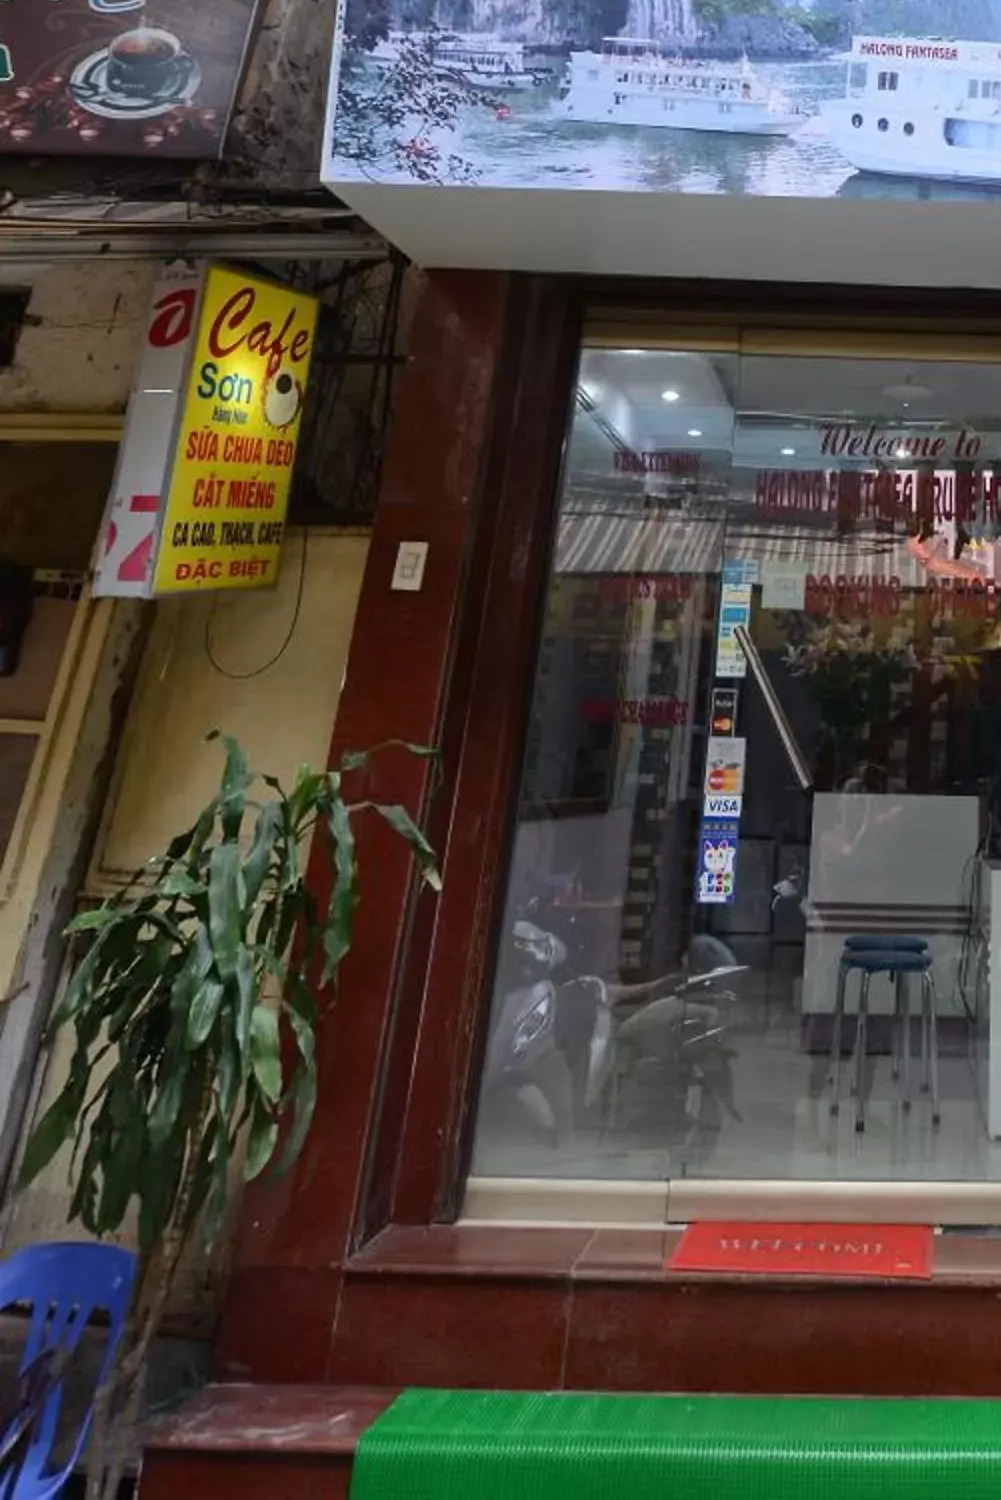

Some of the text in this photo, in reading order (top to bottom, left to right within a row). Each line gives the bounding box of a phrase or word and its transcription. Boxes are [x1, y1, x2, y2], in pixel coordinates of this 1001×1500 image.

[208, 287, 311, 381] Cafe
[197, 362, 253, 406] Sơn
[223, 434, 262, 466] CHUA
[819, 422, 982, 459] Welcome to
[709, 799, 738, 813] VISA
